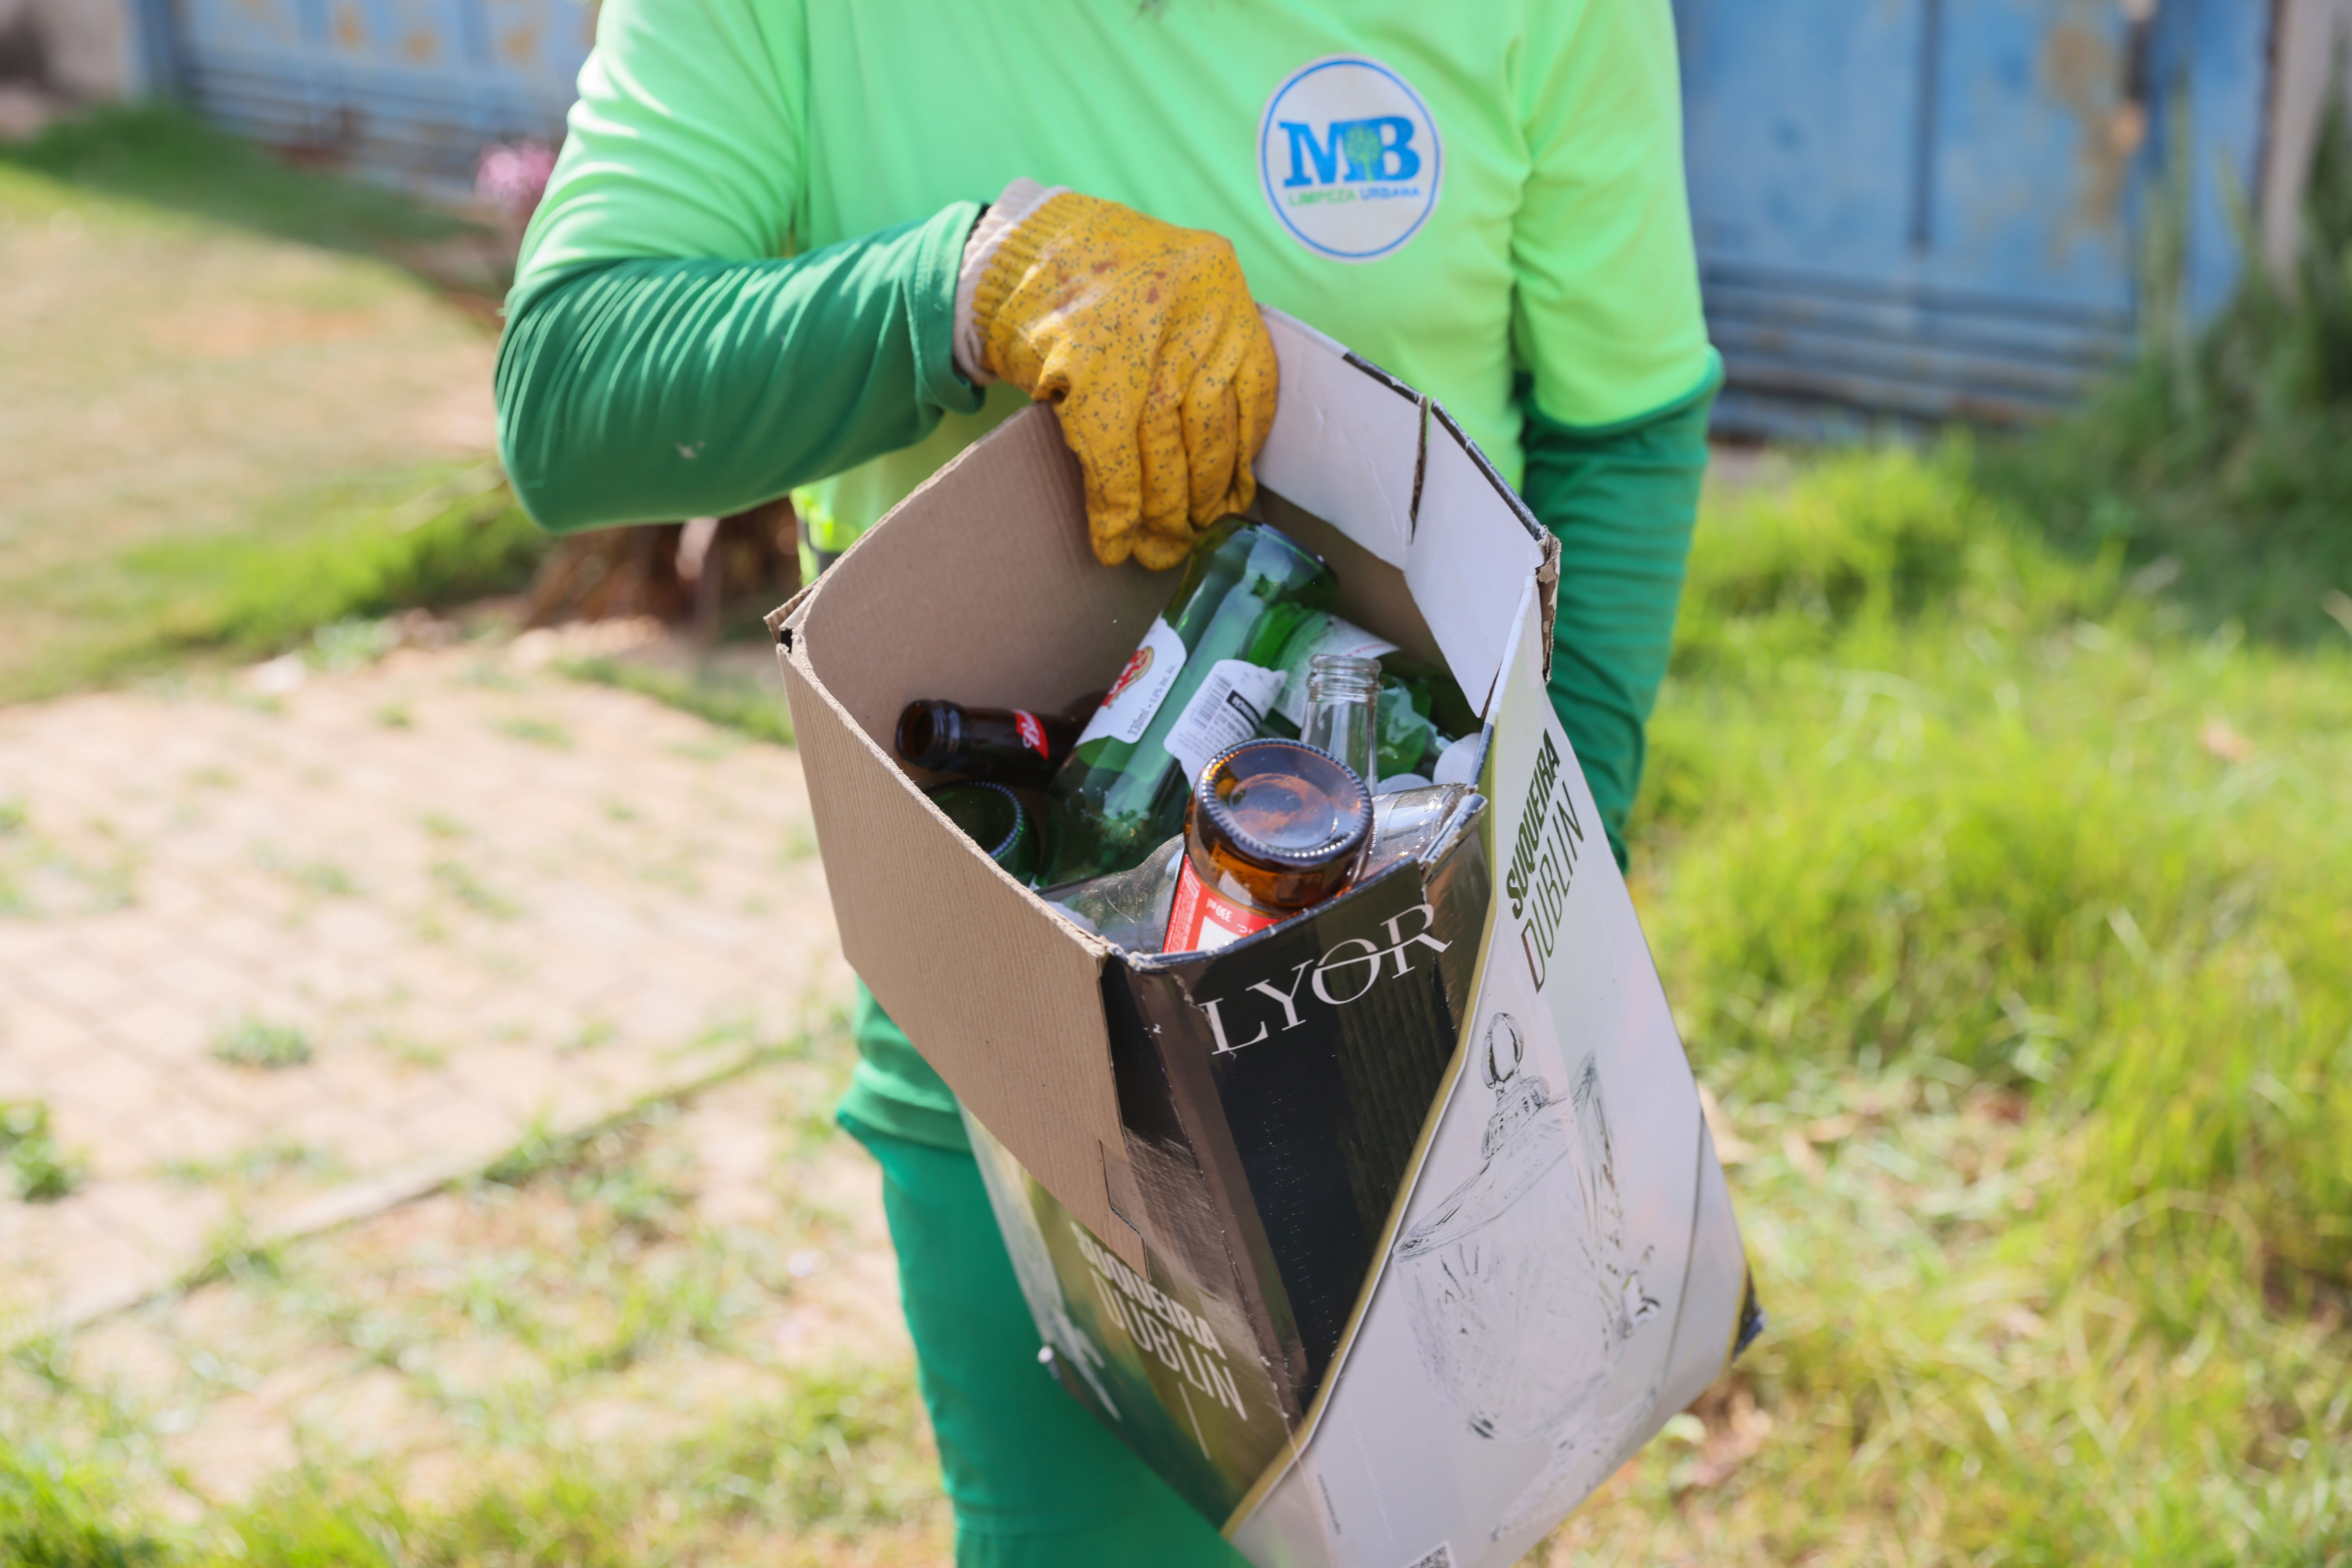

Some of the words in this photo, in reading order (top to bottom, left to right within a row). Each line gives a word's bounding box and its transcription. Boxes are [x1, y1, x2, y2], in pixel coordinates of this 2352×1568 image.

[1278, 116, 1421, 187] MB
[1289, 190, 1356, 206] LIMPEZA
[1361, 187, 1420, 200] URBANA
[1127, 708, 1150, 737] 330ml
[1506, 727, 1560, 920] SUQUEIRA
[1521, 780, 1584, 994] DUBLIN
[1198, 903, 1453, 1055] LYOR
[1069, 1221, 1227, 1360] SUQUEIRA
[1089, 1267, 1248, 1421] DUBLIN
